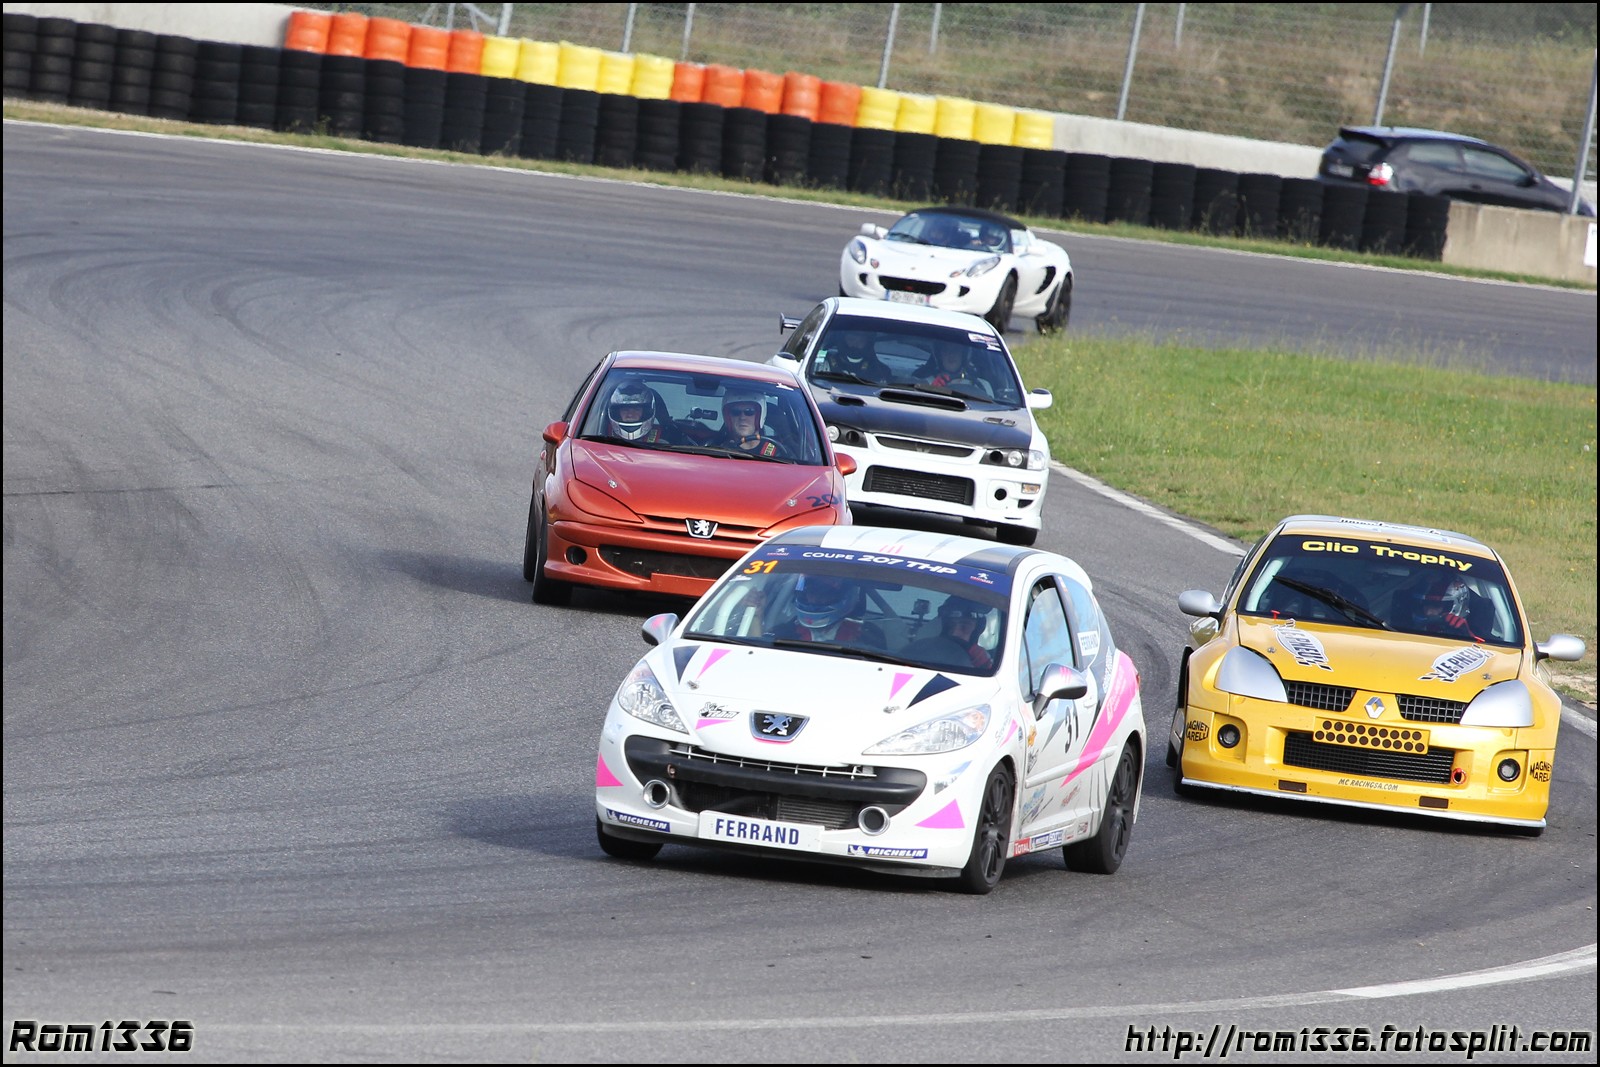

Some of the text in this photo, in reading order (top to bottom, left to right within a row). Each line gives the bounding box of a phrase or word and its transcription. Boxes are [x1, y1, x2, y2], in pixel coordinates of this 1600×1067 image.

[802, 551, 958, 575] COUPE 207 THP
[1302, 541, 1473, 572] Clio Trophy
[743, 560, 778, 575] 31
[1065, 700, 1079, 753] 31
[1338, 778, 1349, 786] MC
[618, 812, 669, 831] MICHELIN
[715, 817, 799, 845] FERRAND
[867, 848, 926, 858] MICHELIN
[1014, 842, 1030, 854] TOTAL
